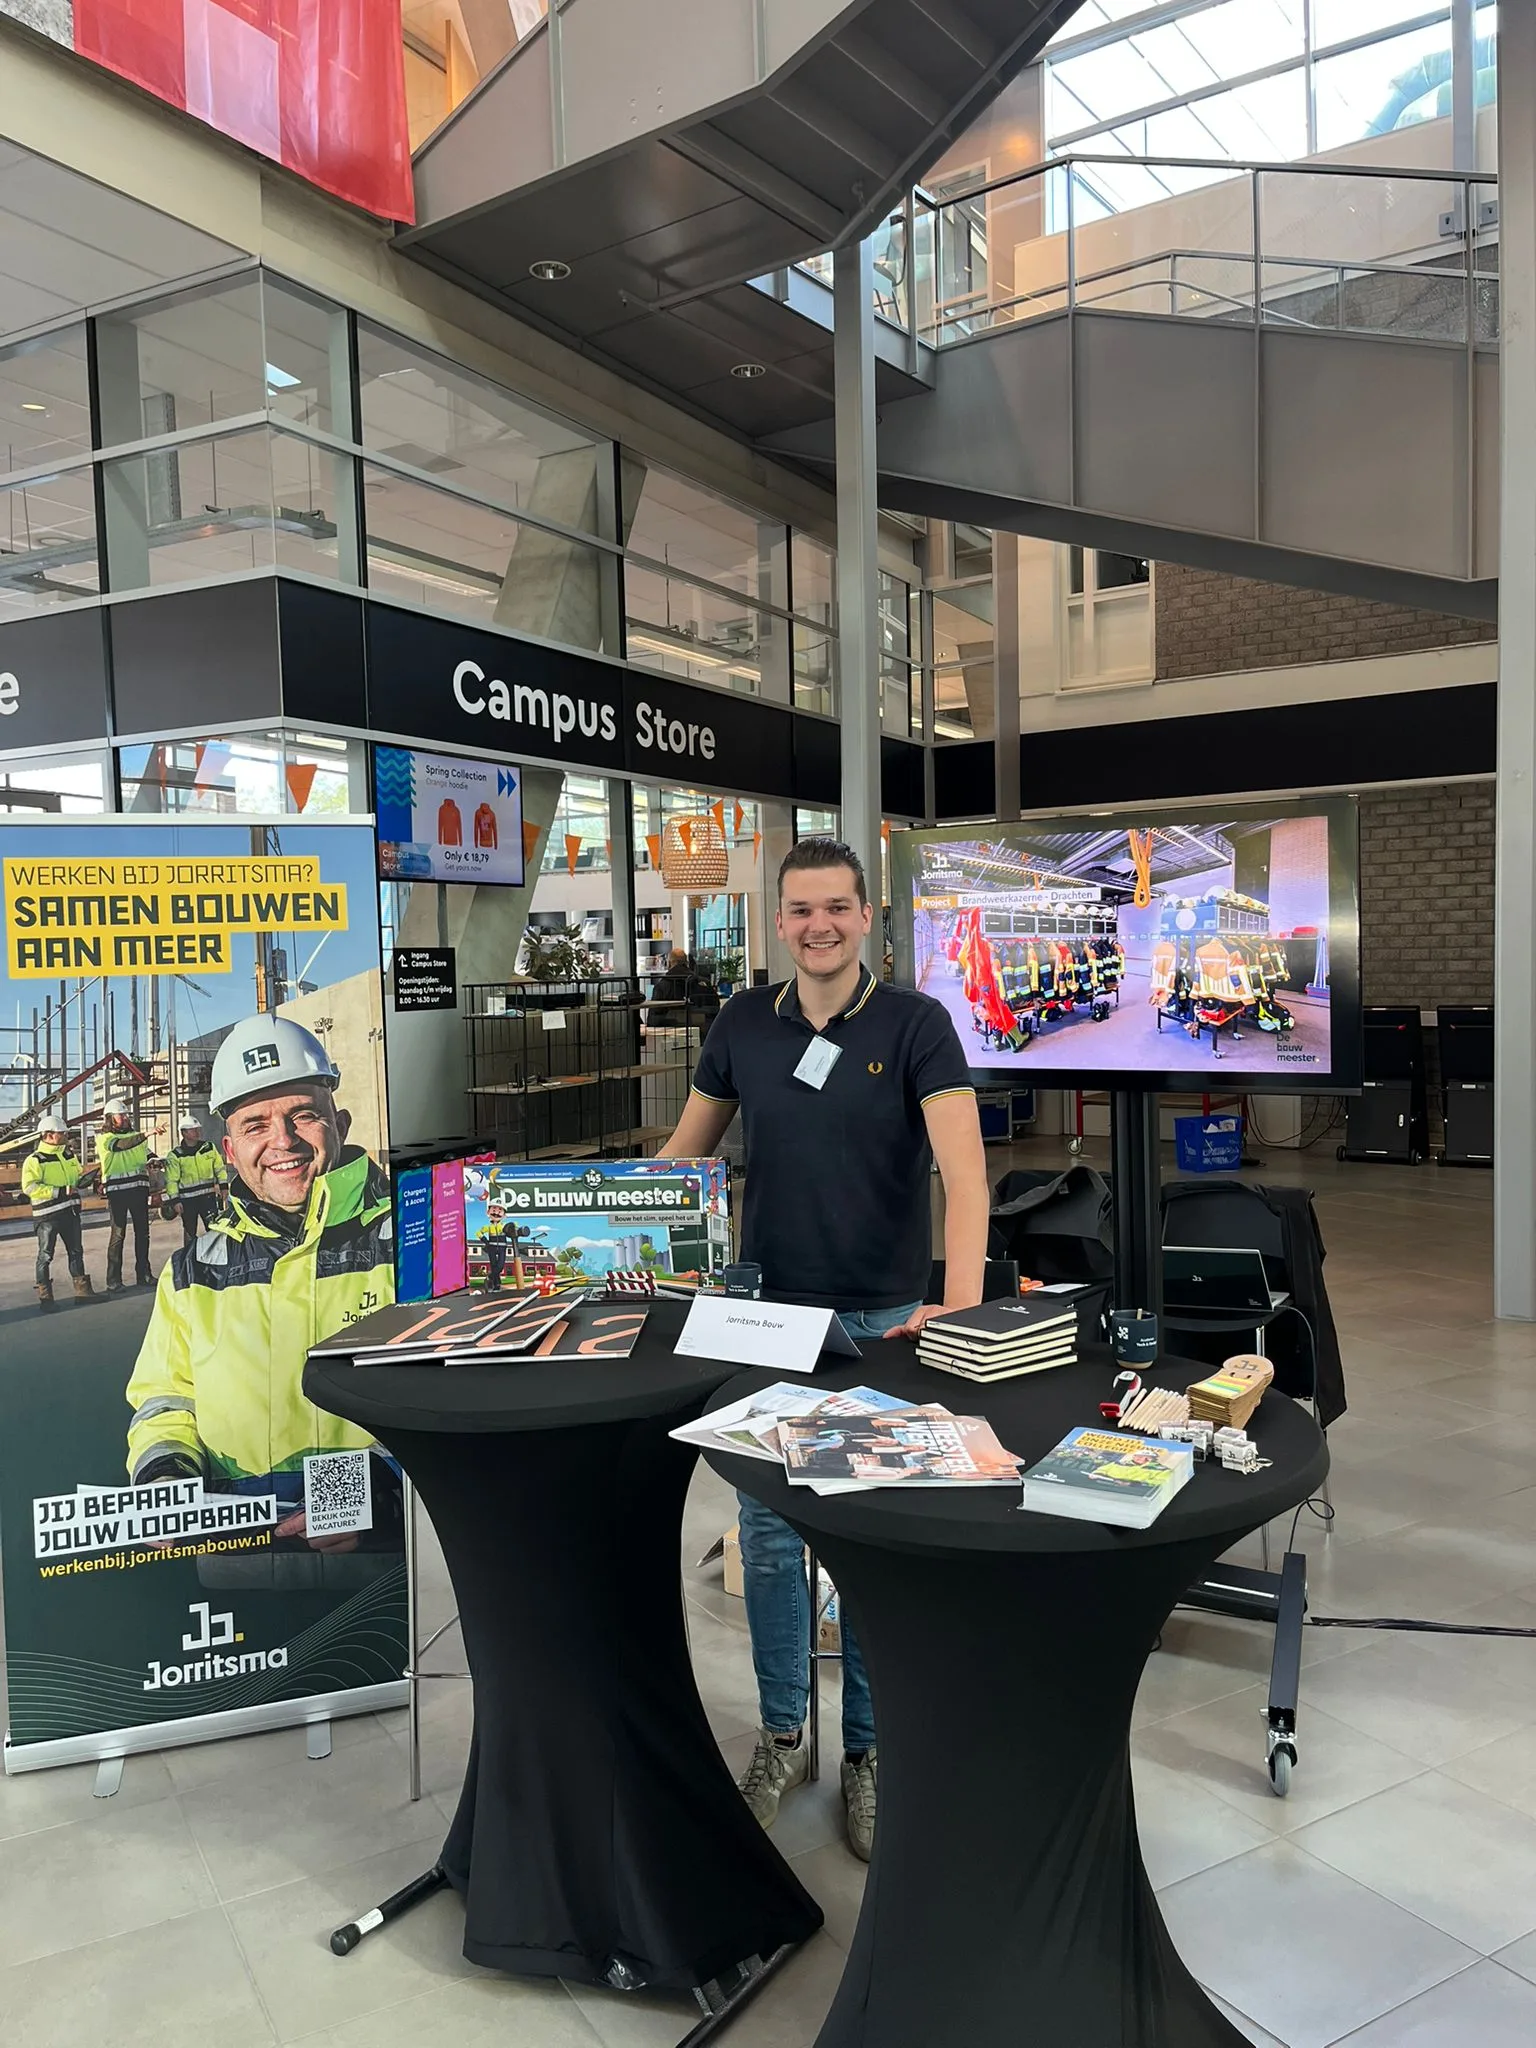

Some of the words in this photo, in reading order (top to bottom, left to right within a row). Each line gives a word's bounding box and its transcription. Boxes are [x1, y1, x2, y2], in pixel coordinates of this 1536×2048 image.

[453, 660, 617, 743] Campus
[636, 701, 717, 760] Store
[425, 765, 449, 778] Spring
[451, 769, 487, 781] Collection
[449, 781, 468, 790] hoodie
[382, 849, 409, 859] Campus
[444, 851, 462, 861] Only
[471, 853, 489, 864] 18,79
[456, 864, 470, 872] yours
[11, 865, 115, 886] WERKEN
[123, 864, 159, 885] BIJ
[166, 863, 314, 885] JORRITSMA?
[921, 869, 963, 880] Jorritsma
[921, 898, 951, 909] Project
[962, 893, 1043, 906] Brandweerkazerne
[1051, 891, 1093, 901] Drachten
[14, 895, 160, 928] SAMEN
[171, 892, 339, 923] BOUWEN
[17, 936, 102, 968] AAN
[113, 933, 225, 966] MEER
[411, 952, 429, 960] Ingang
[411, 960, 432, 968] Campus
[398, 975, 440, 985] Openingstijden:
[399, 986, 423, 995] Maandag
[423, 985, 434, 994] t/m
[435, 985, 453, 994] vrijdag
[1277, 1033, 1290, 1042] De
[1277, 1043, 1303, 1051] bouw
[442, 1179, 456, 1189] Small
[585, 1173, 601, 1183] 145
[403, 1186, 427, 1198] Chargers
[443, 1189, 455, 1198] Tech
[500, 1188, 530, 1208] De
[534, 1187, 593, 1208] bouw
[597, 1186, 690, 1207] meester.
[645, 1214, 657, 1223] slim,
[658, 1214, 673, 1223] speel
[686, 1213, 695, 1221] uit
[725, 1315, 761, 1327] Jorritsma
[762, 1319, 785, 1329] Bouw
[38, 1501, 76, 1525] JIJ
[84, 1481, 200, 1519] BEPAALT
[311, 1512, 337, 1522] BEKIJK
[338, 1509, 361, 1519] ONZE
[39, 1521, 120, 1553] JOUW
[127, 1500, 272, 1541] LOOPBAAN
[312, 1518, 357, 1532] VACATURES
[40, 1531, 272, 1579] werkenbij.jorritsmabouw.nl
[143, 1647, 288, 1691] Jorritsma
